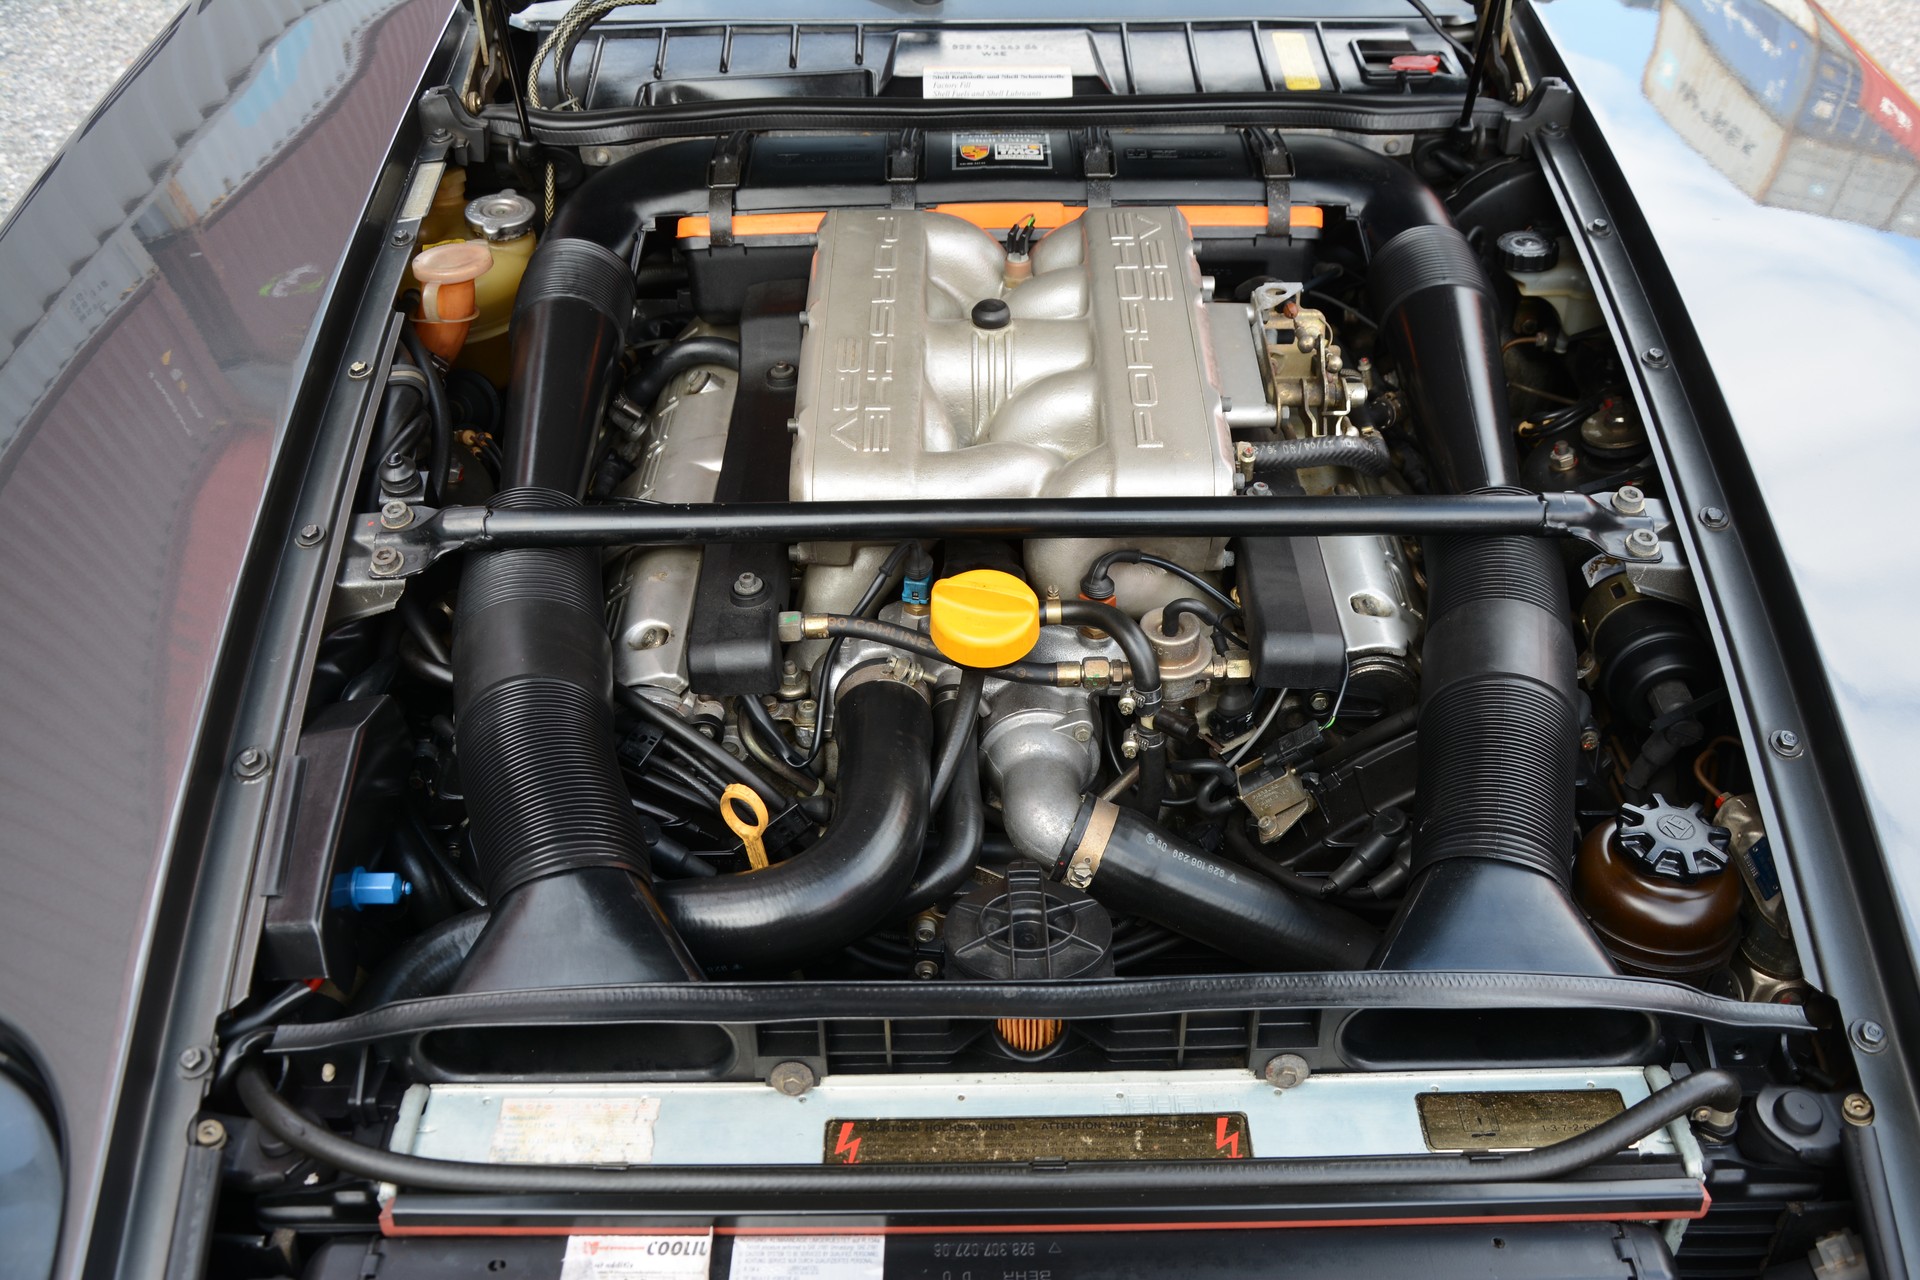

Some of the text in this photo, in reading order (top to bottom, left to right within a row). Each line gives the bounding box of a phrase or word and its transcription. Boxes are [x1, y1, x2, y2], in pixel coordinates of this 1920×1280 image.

[1133, 214, 1173, 301] 32V
[863, 216, 898, 452] PORSCHE
[1108, 212, 1164, 448] PORSCHE
[830, 337, 863, 451] 32V
[1173, 849, 1190, 863] 239
[1191, 857, 1206, 871] 106
[1208, 864, 1225, 878] 928
[868, 1123, 1016, 1133] ACHTUNG HOCHSPANNUNG
[1041, 1119, 1204, 1130] ATTENTION HAUTE TENSION
